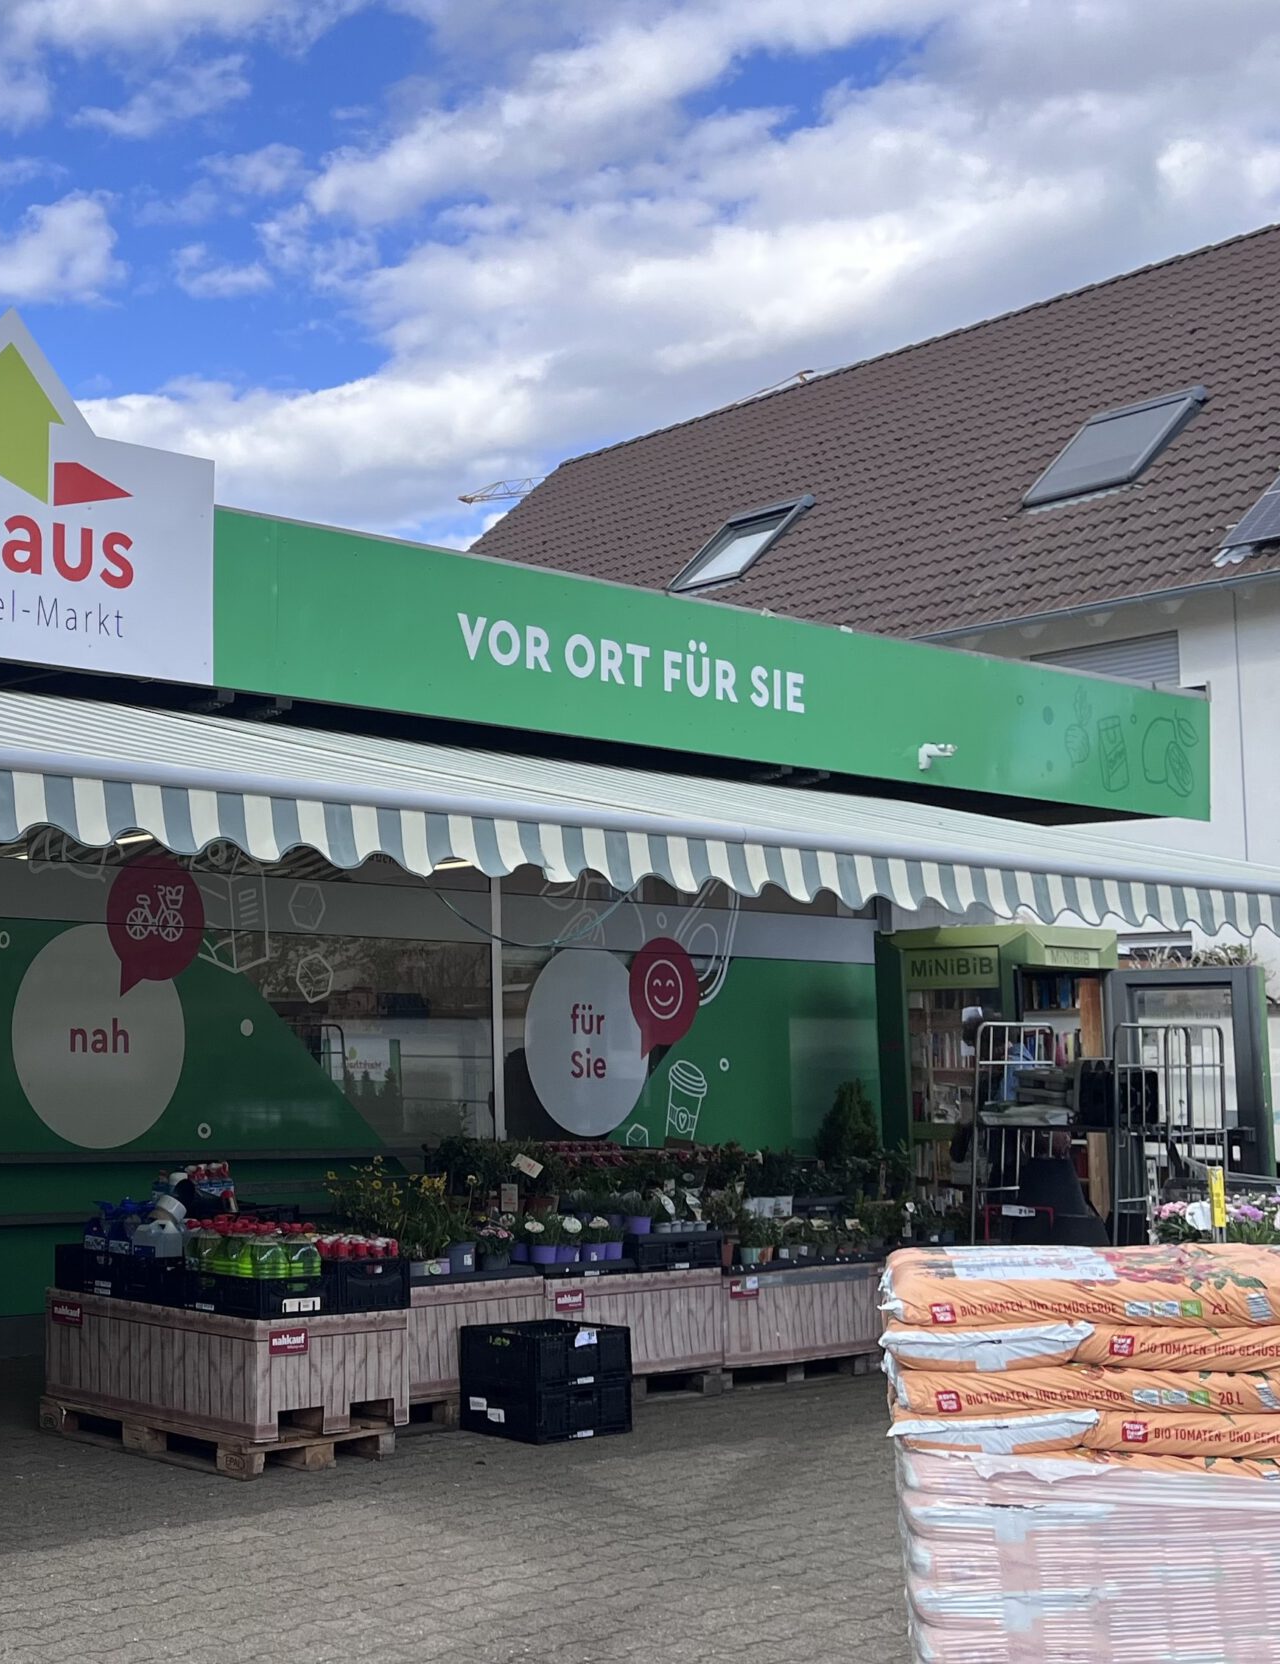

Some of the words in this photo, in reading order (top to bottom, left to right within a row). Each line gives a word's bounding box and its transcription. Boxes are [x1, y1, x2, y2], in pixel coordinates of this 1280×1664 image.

[457, 612, 552, 673] VOR
[564, 633, 650, 688] ORT
[663, 639, 738, 703] FÜR
[750, 665, 805, 714] SIE
[570, 1003, 605, 1035] für
[69, 1017, 130, 1054] nah
[570, 1047, 607, 1079] Sie
[1219, 1392, 1233, 1406] 20
[1237, 1391, 1244, 1406] L
[1154, 1428, 1171, 1440] BIO
